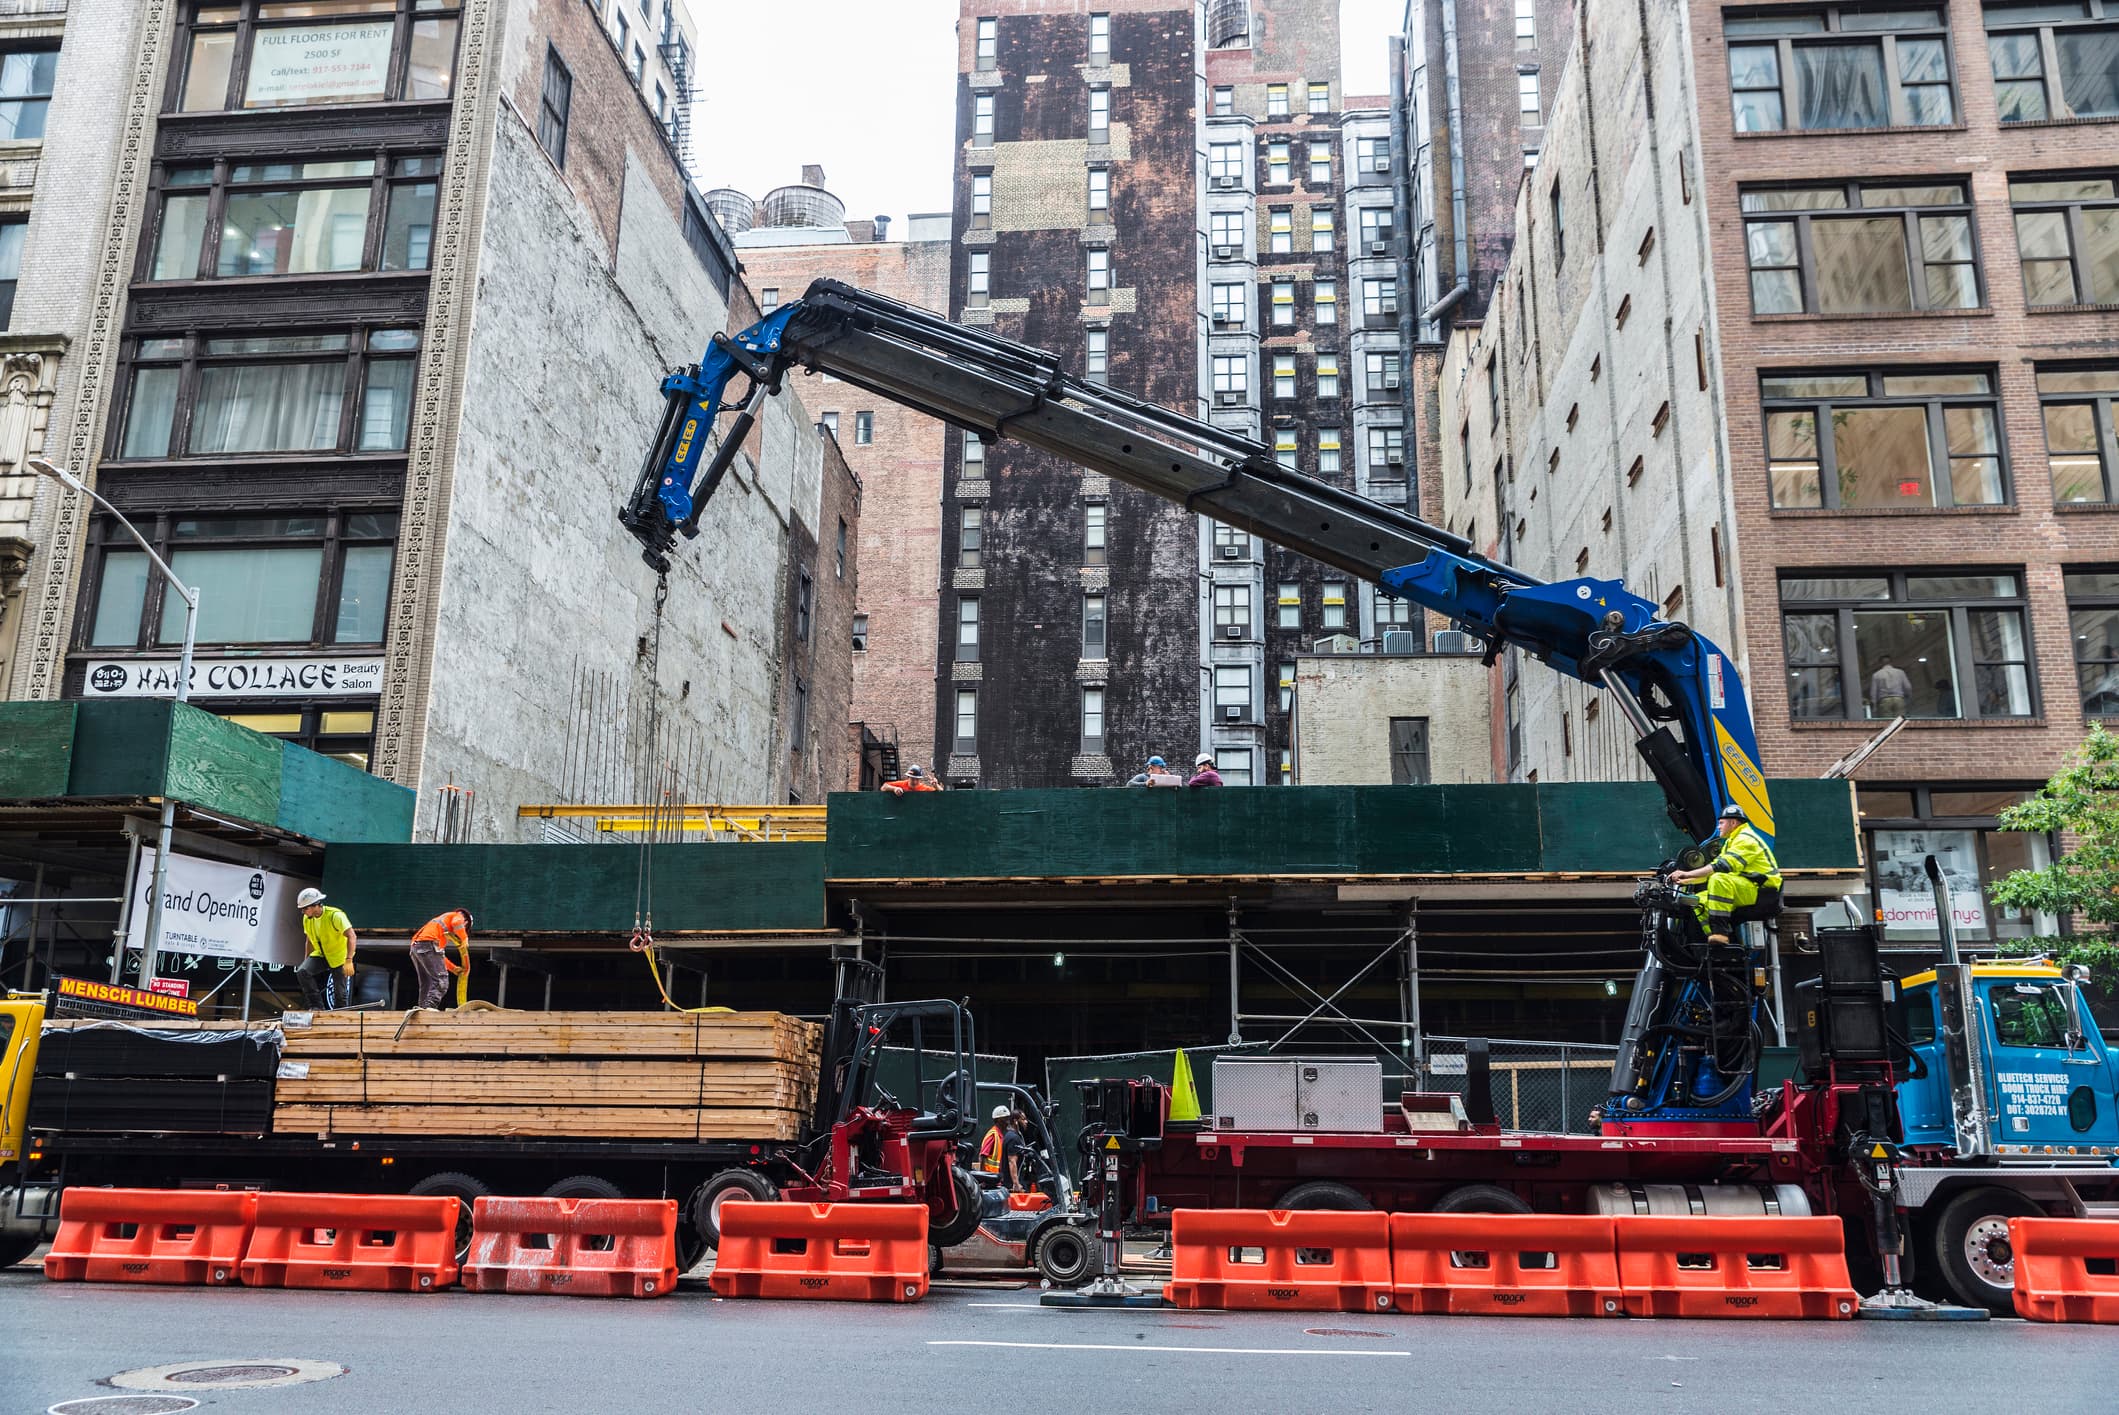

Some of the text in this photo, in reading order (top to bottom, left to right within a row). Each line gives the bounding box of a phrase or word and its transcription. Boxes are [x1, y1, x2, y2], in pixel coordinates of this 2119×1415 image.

[262, 29, 388, 45] FULL FLOORS FOR RENT
[304, 49, 342, 59] 2500 SF
[343, 664, 380, 675] Beauty
[208, 664, 337, 690] COLLAGE
[341, 679, 372, 689] Salon
[1725, 744, 1759, 785] EFFER
[145, 884, 258, 926] and Opening
[165, 931, 198, 943] TURNTABLE
[162, 982, 185, 990] STANDING
[61, 979, 197, 1014] MENSCH LUMBER
[1998, 1072, 2069, 1084] BLUETECH SERVICES
[2002, 1083, 2068, 1095] BOOM TRUCK HIRE
[2006, 1104, 2024, 1115] DOT:
[2058, 1105, 2068, 1116] NY
[1268, 1288, 1300, 1296] YODOCK
[1493, 1293, 1526, 1302] YODOCK
[1725, 1296, 1758, 1304] YODOCK
